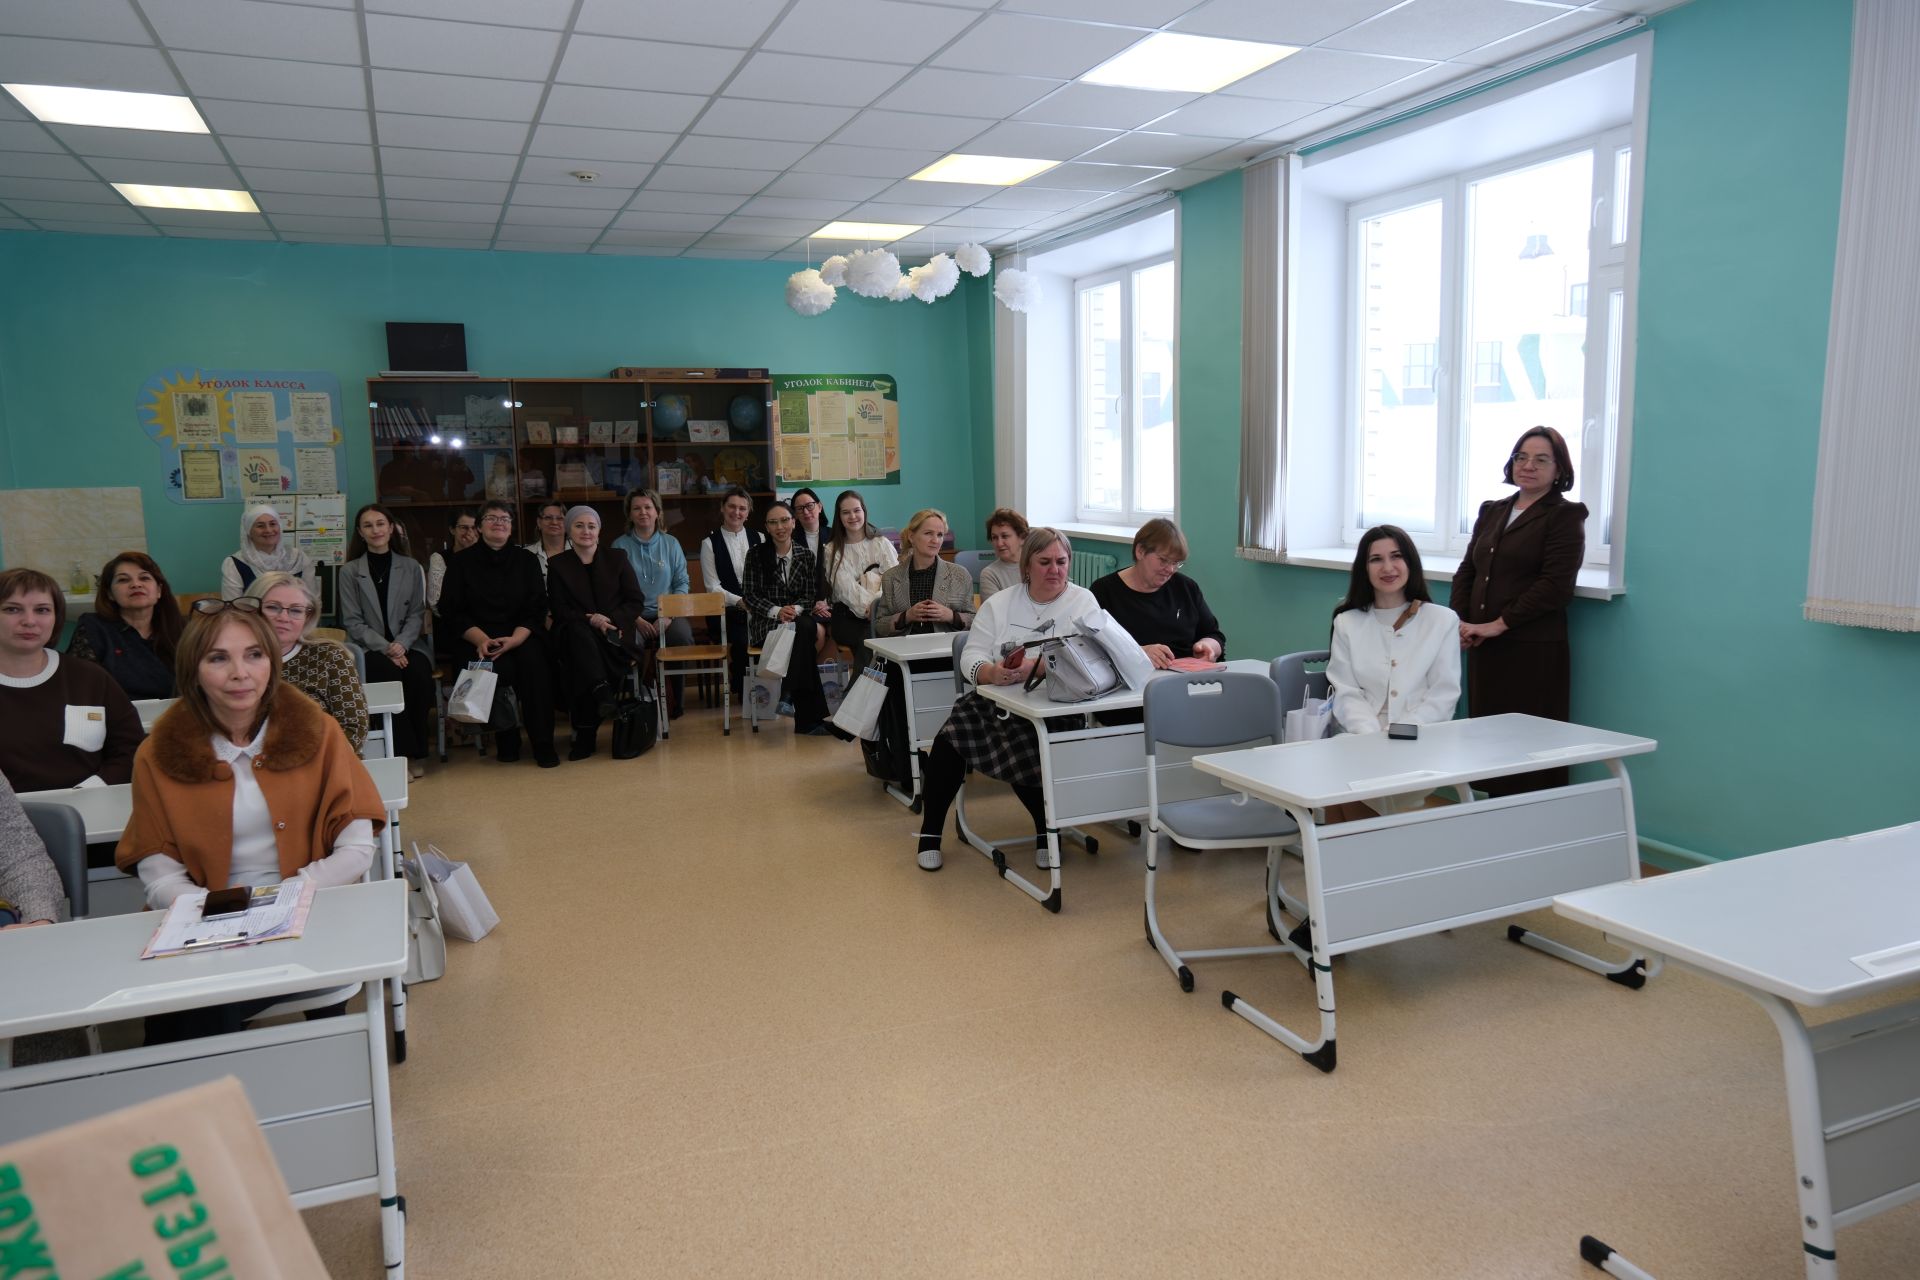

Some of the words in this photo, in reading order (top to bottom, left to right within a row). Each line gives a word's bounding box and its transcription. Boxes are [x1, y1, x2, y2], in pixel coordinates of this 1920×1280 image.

[197, 379, 250, 390] УГОЛОК
[254, 379, 305, 390] КЛАССА
[784, 378, 822, 389] УГОЛОК
[826, 378, 876, 389] КАБИНЕТА
[129, 1143, 235, 1280] ОТЗЫ
